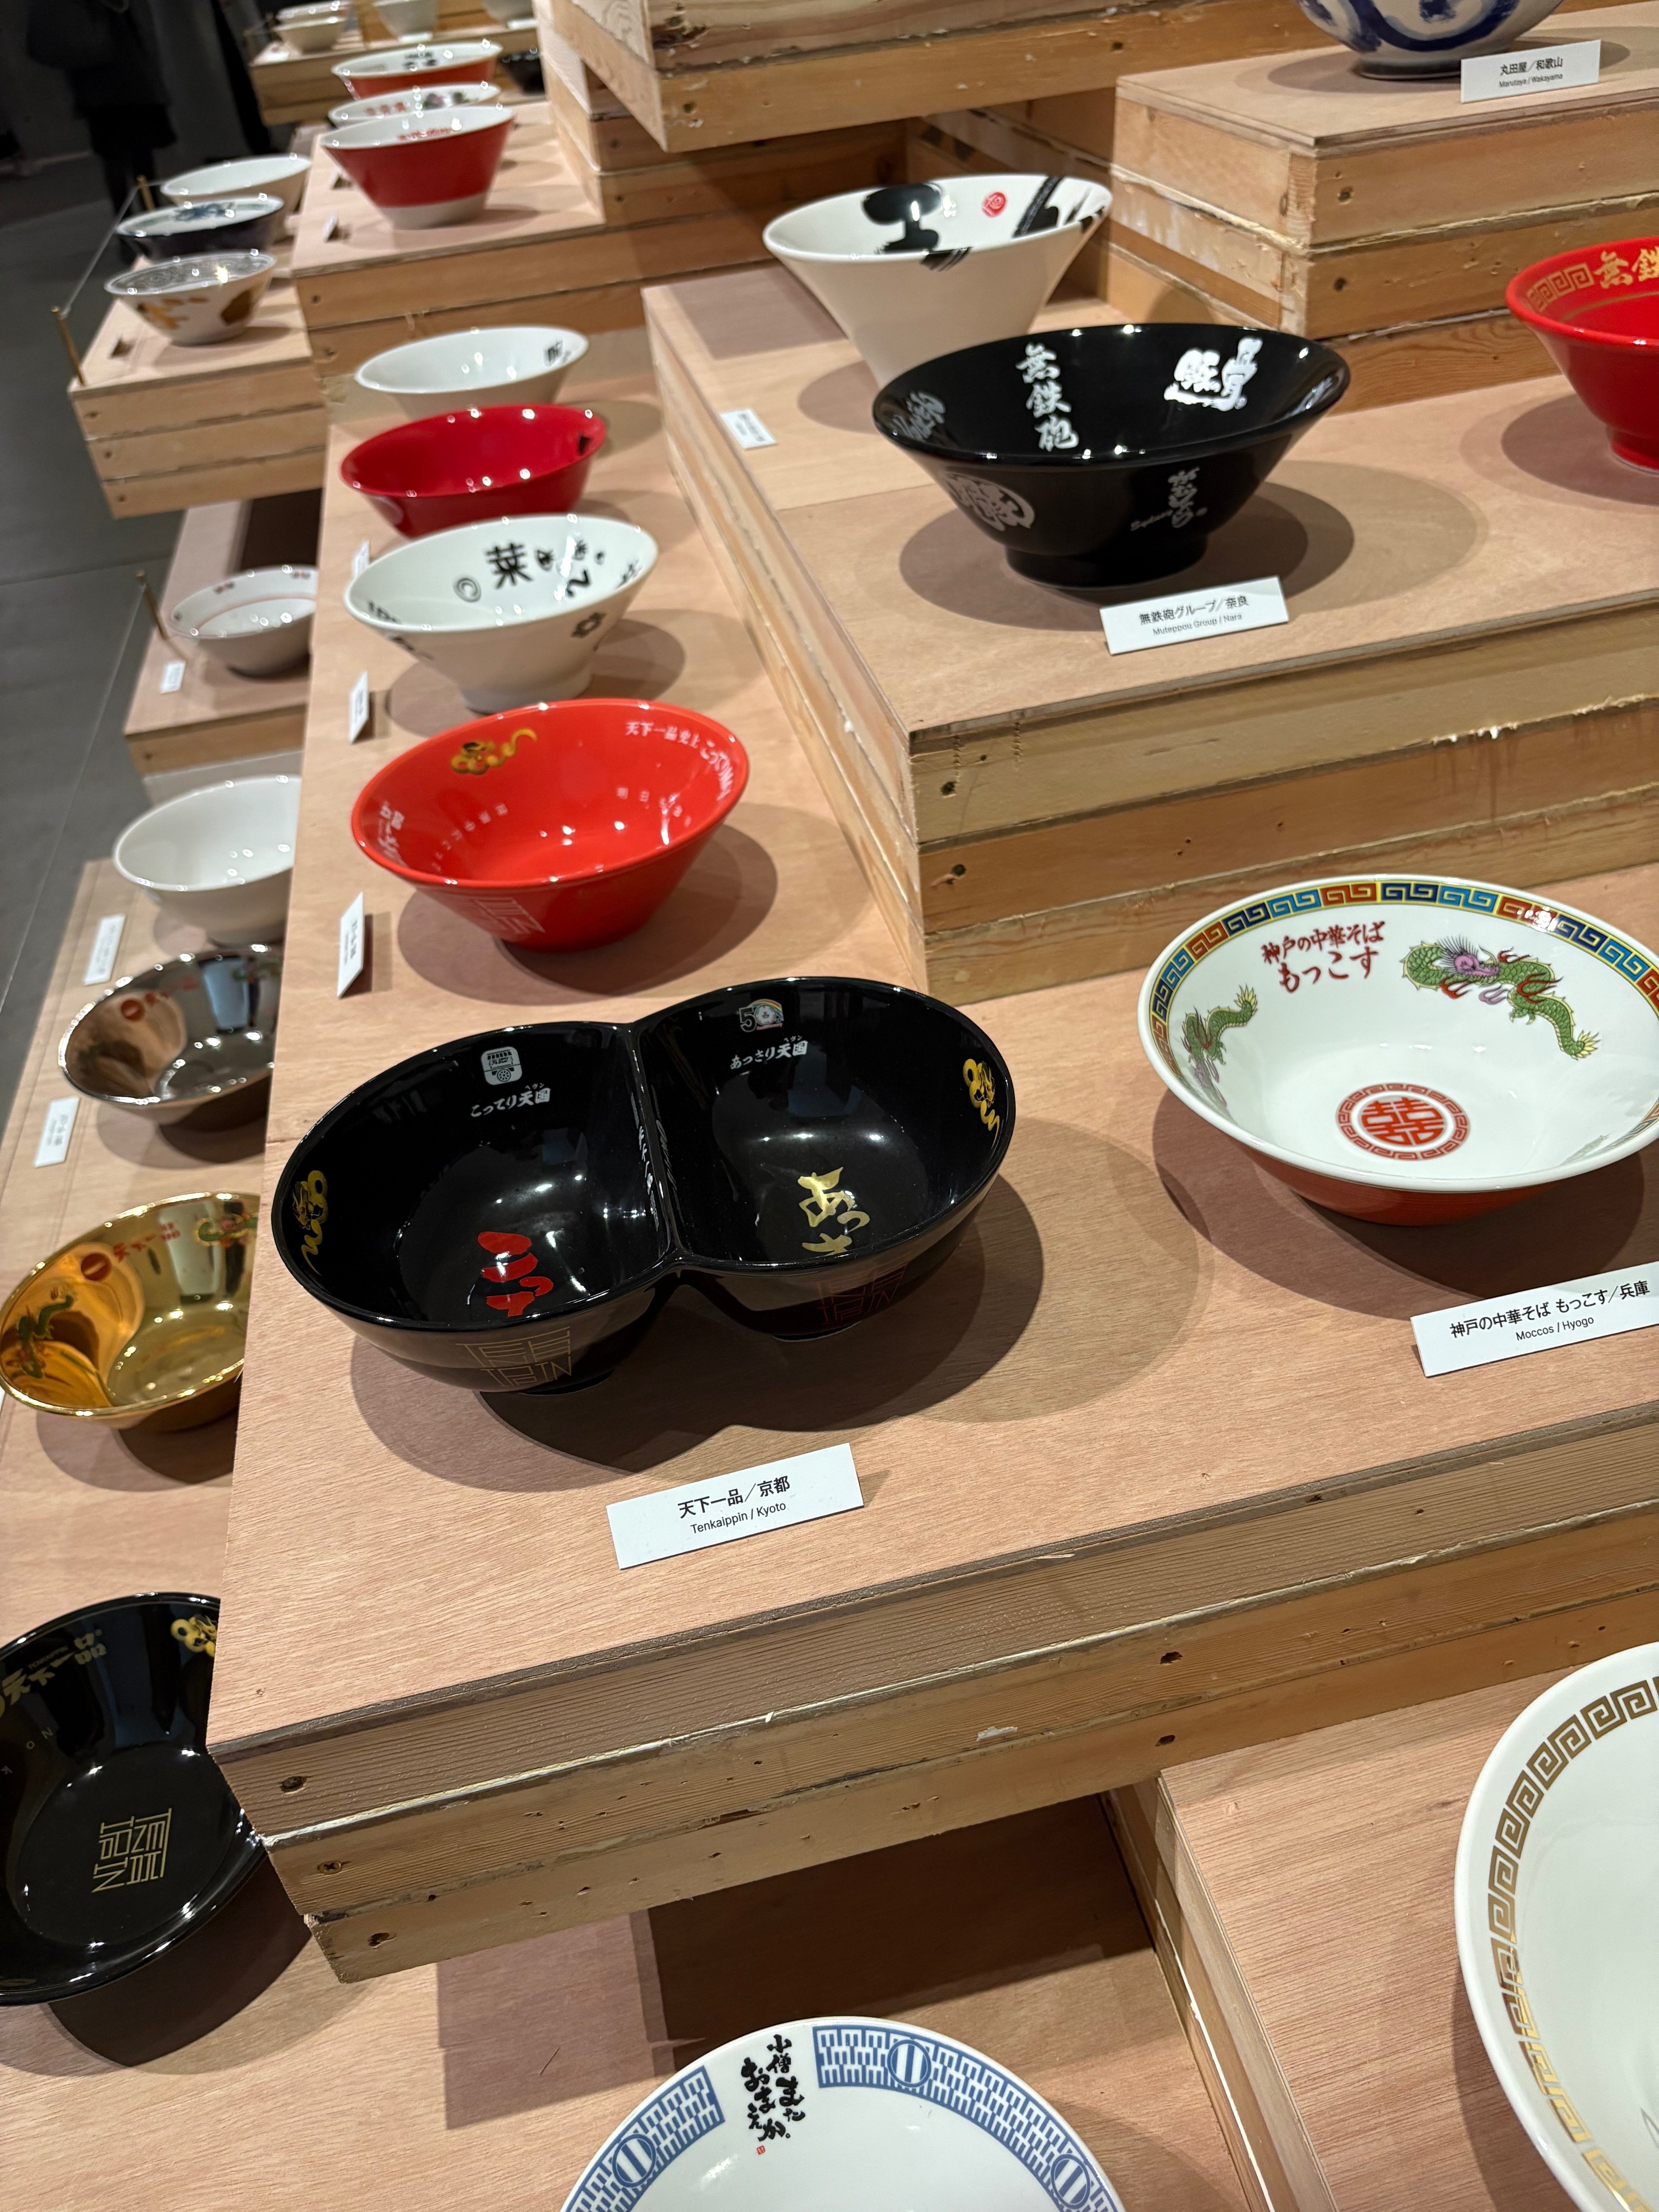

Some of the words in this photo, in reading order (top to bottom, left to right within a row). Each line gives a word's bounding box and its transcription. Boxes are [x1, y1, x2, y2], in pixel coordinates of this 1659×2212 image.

[1153, 623, 1192, 635] Muteppou
[1193, 618, 1217, 628] Group
[1223, 614, 1242, 623] Nara
[1261, 921, 1385, 964] 神戸の中華そば
[1278, 946, 1379, 993] もっこす
[730, 1040, 808, 1069] あっさり天国
[471, 1087, 551, 1117] こってり天国
[1449, 1301, 1551, 1338] 神戸の中華そば
[1556, 1280, 1650, 1313] もっこす／兵庫
[1516, 1325, 1554, 1341] Moccos
[1563, 1316, 1594, 1331] Hyogo
[677, 1475, 790, 1518] 天下一品／京都
[690, 1512, 748, 1534] Tenkaippin
[756, 1501, 787, 1518] Kyoto
[766, 2034, 806, 2122] 小僧また
